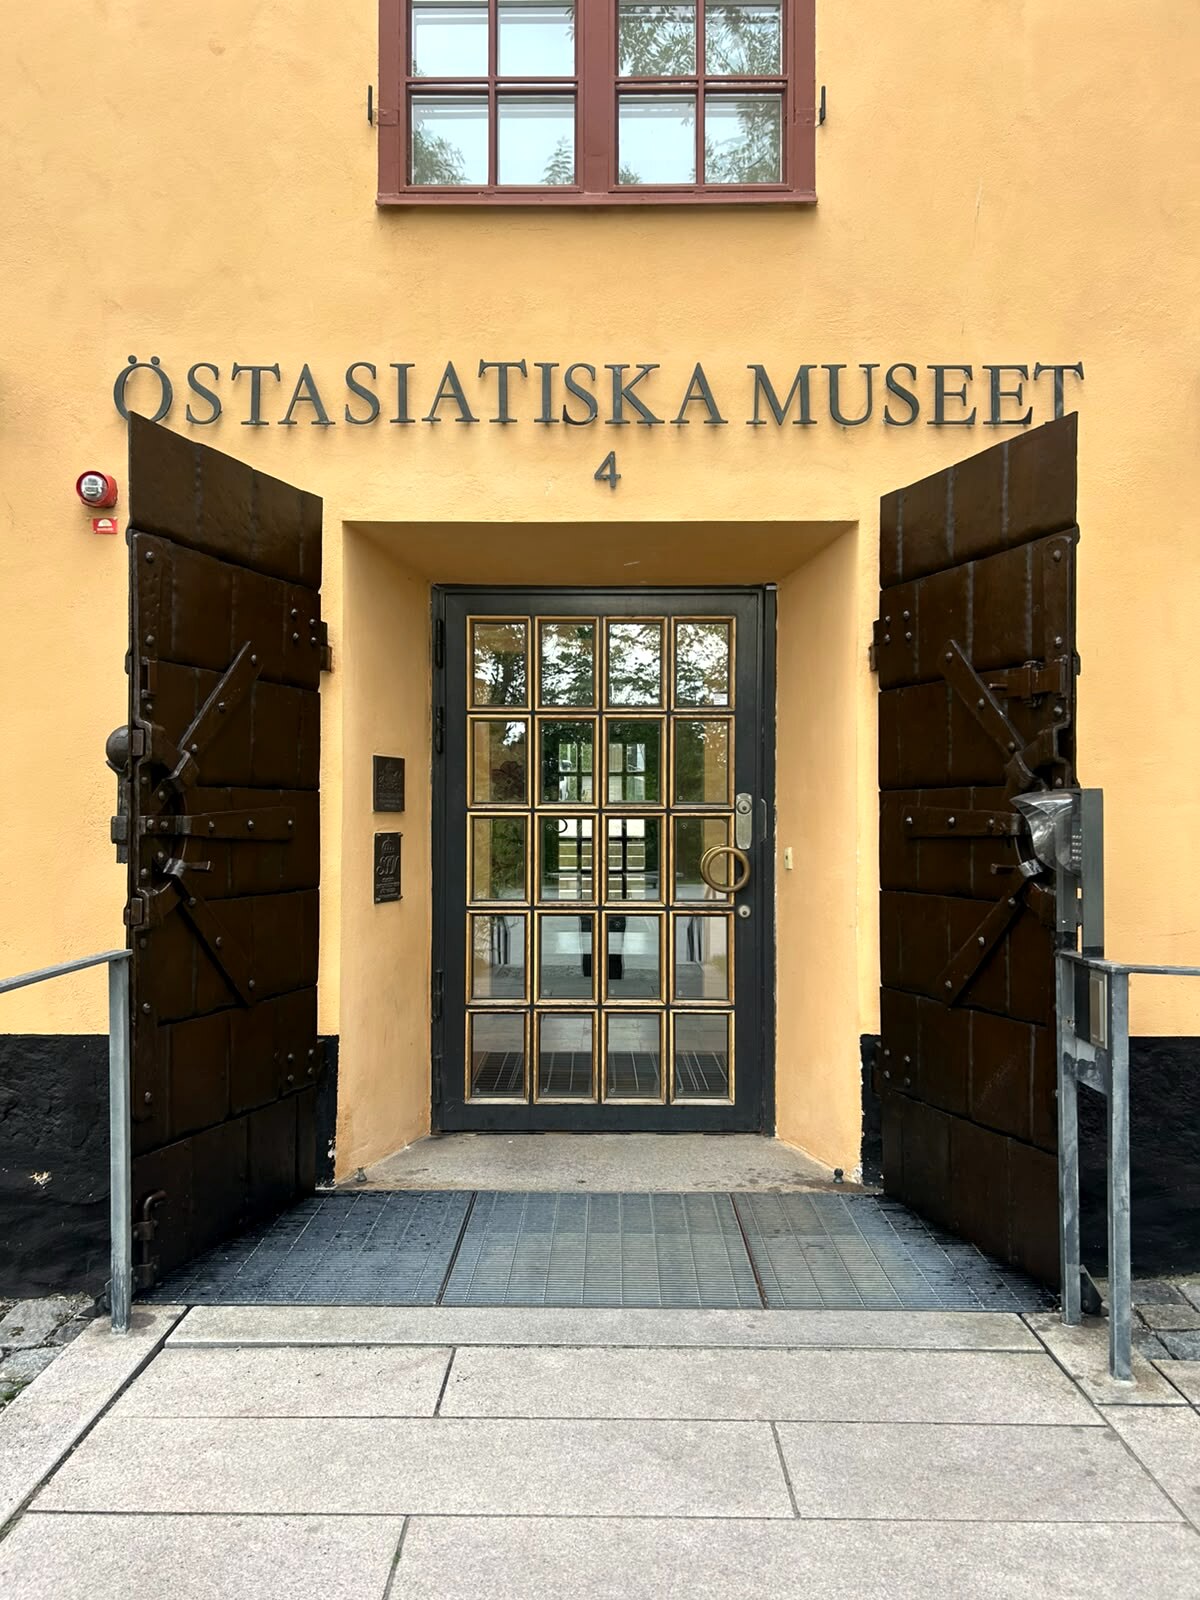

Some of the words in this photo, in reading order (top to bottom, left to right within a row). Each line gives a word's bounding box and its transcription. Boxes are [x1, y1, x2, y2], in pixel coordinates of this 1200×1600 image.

[114, 355, 728, 429] ÖSTASIATISKA
[746, 361, 1083, 429] MUSEET
[594, 451, 621, 488] 4
